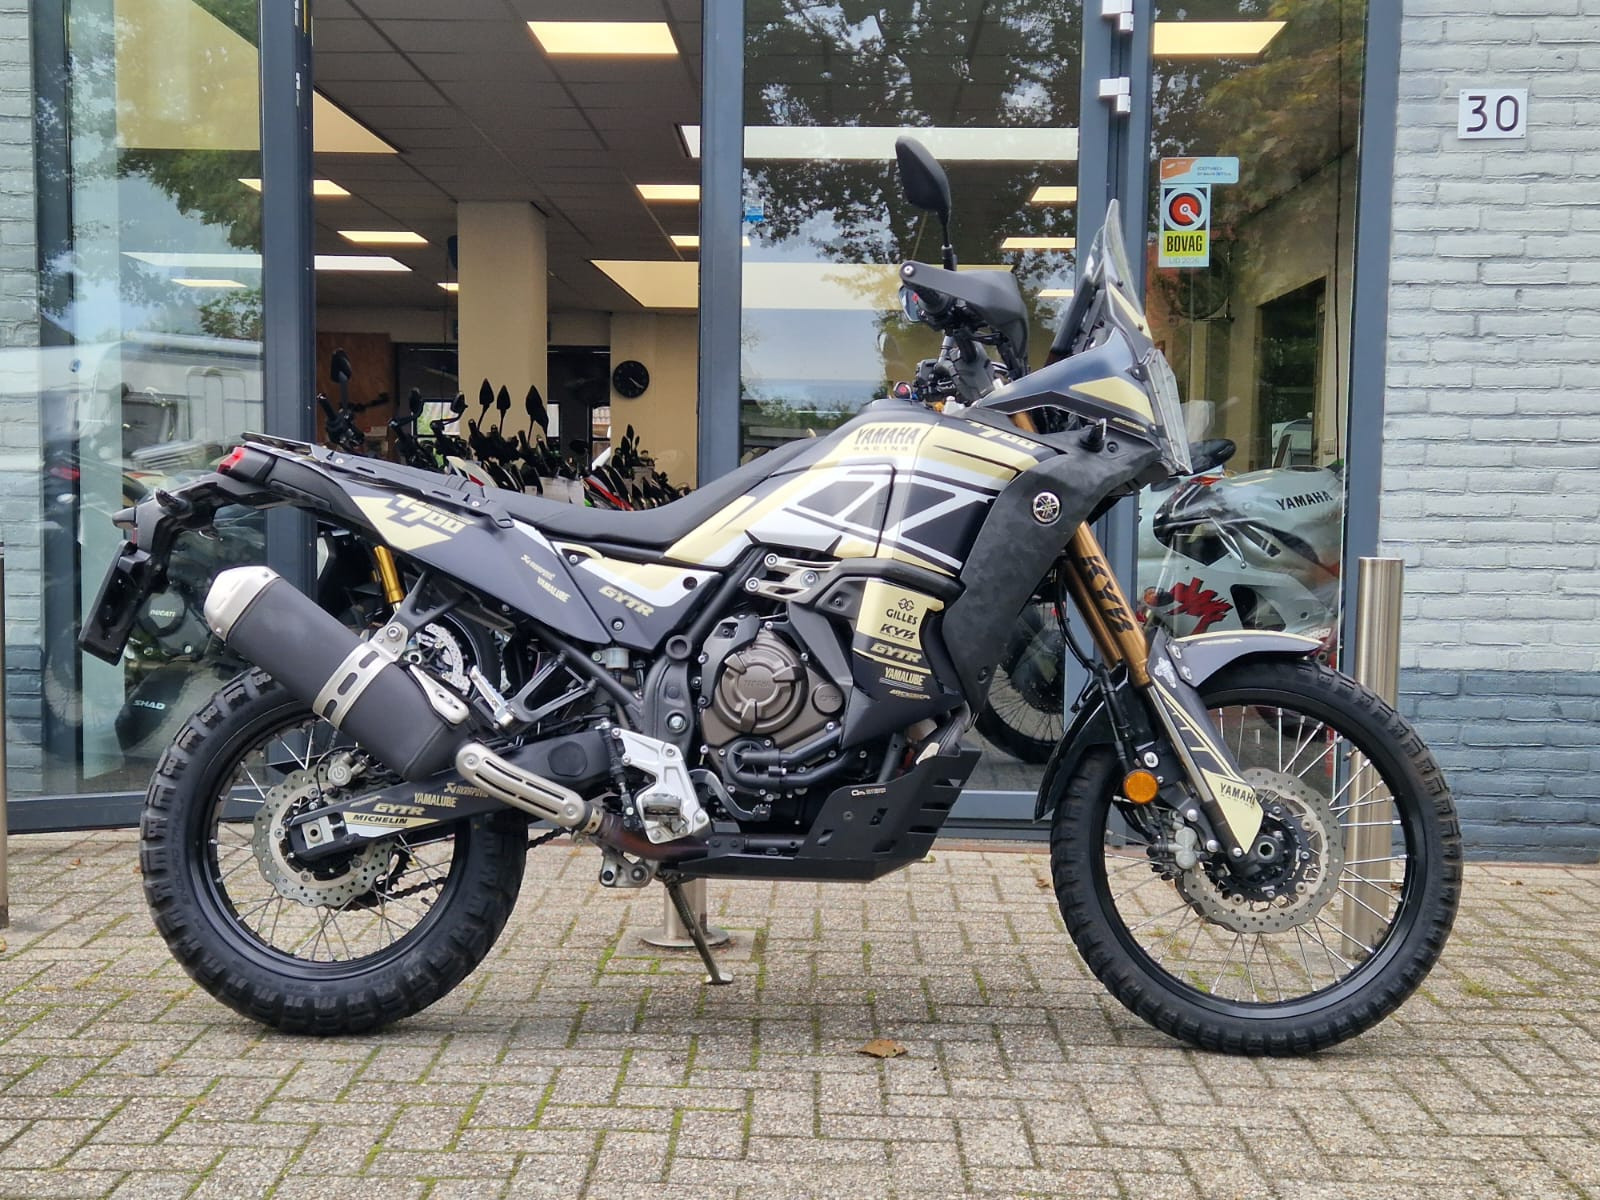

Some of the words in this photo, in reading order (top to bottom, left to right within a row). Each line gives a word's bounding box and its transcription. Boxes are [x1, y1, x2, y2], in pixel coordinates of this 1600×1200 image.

[1466, 94, 1520, 133] 30
[1166, 235, 1203, 253] BOVAG
[854, 426, 921, 446] YAMAHA
[1275, 490, 1334, 511] YAMAHA
[599, 585, 655, 617] GYTR
[149, 609, 176, 618] DUCATI
[886, 608, 919, 626] GILLES
[880, 623, 916, 640] KYB
[870, 642, 923, 663] GYTR
[884, 667, 926, 687] YAMALUBE
[132, 699, 166, 710] SHAD
[373, 802, 426, 816] GYTR
[414, 792, 458, 808] YAMALUBE
[352, 814, 408, 825] MICHELIN
